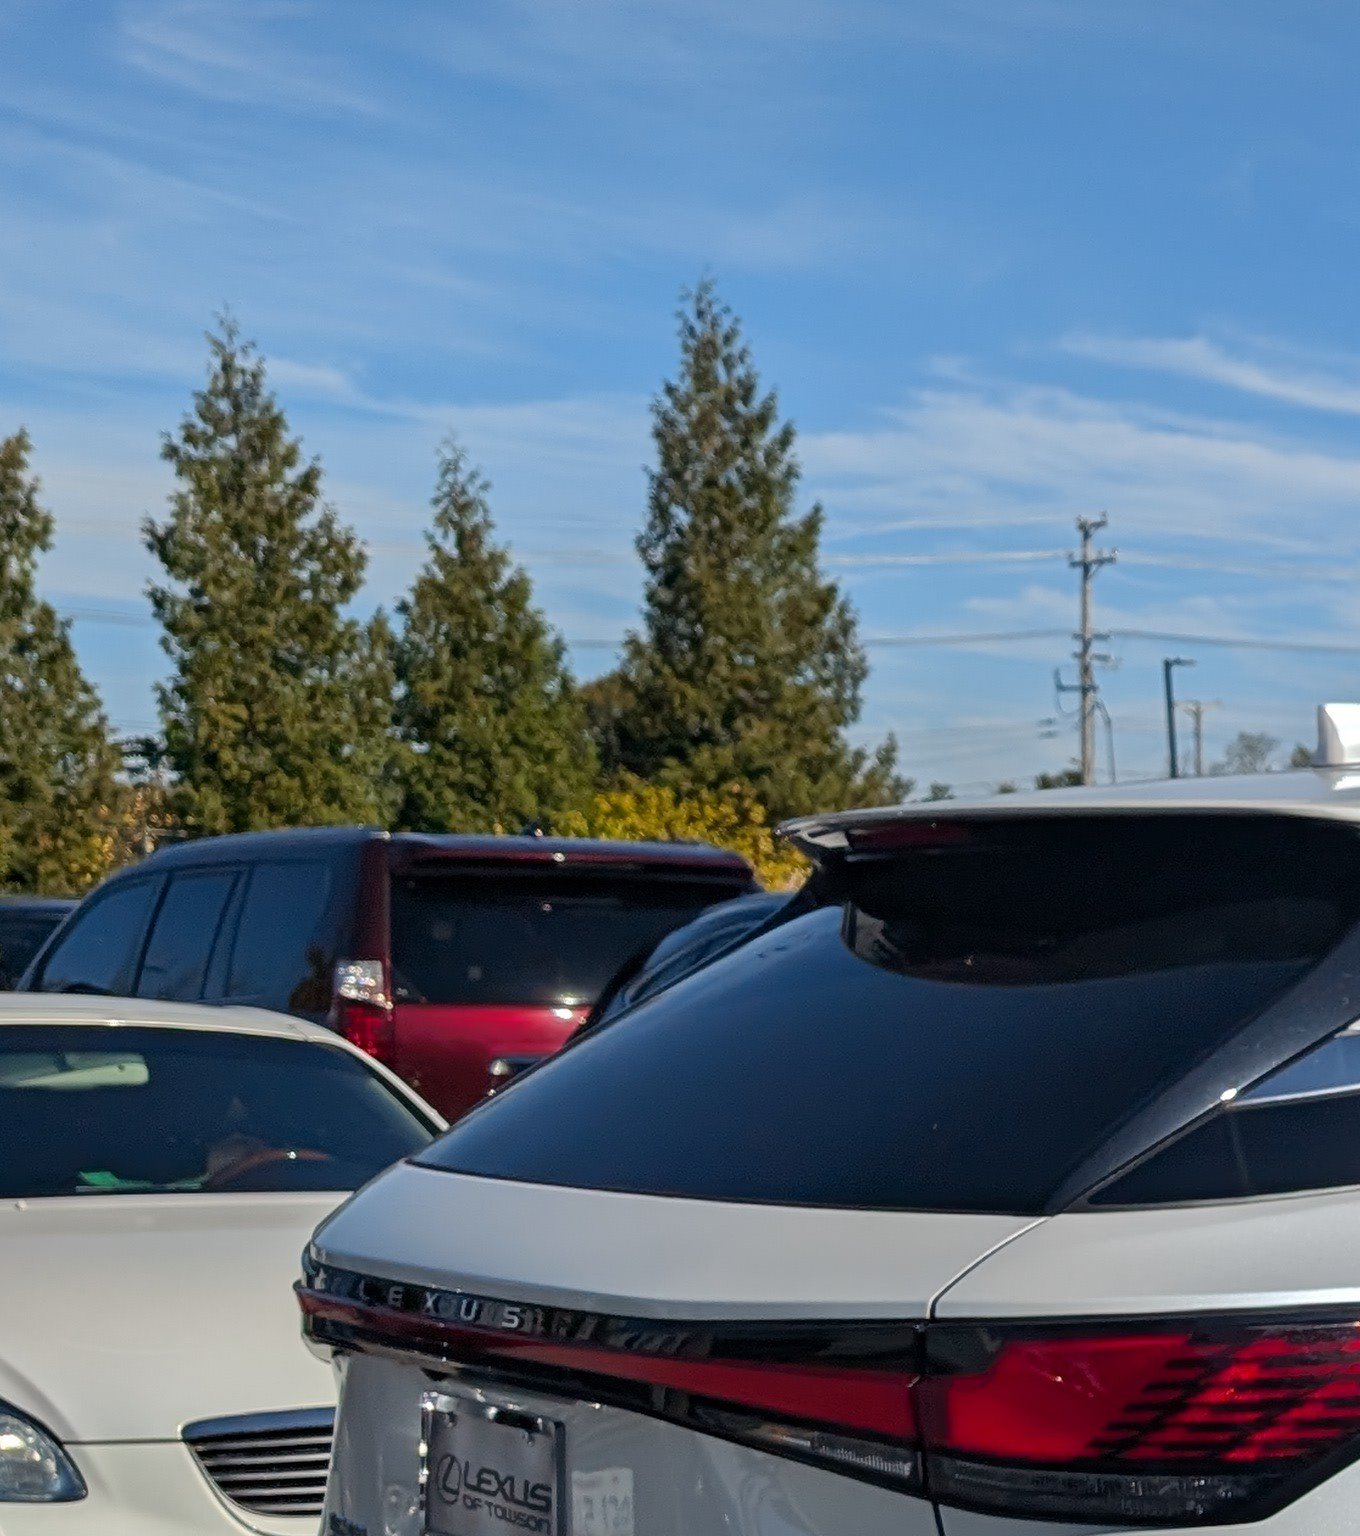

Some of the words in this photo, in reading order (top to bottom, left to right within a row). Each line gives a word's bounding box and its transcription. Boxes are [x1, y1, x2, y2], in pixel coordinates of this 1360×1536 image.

[358, 1282, 521, 1329] LEXUS
[462, 1494, 482, 1511] OF
[463, 1460, 552, 1513] LEXUS
